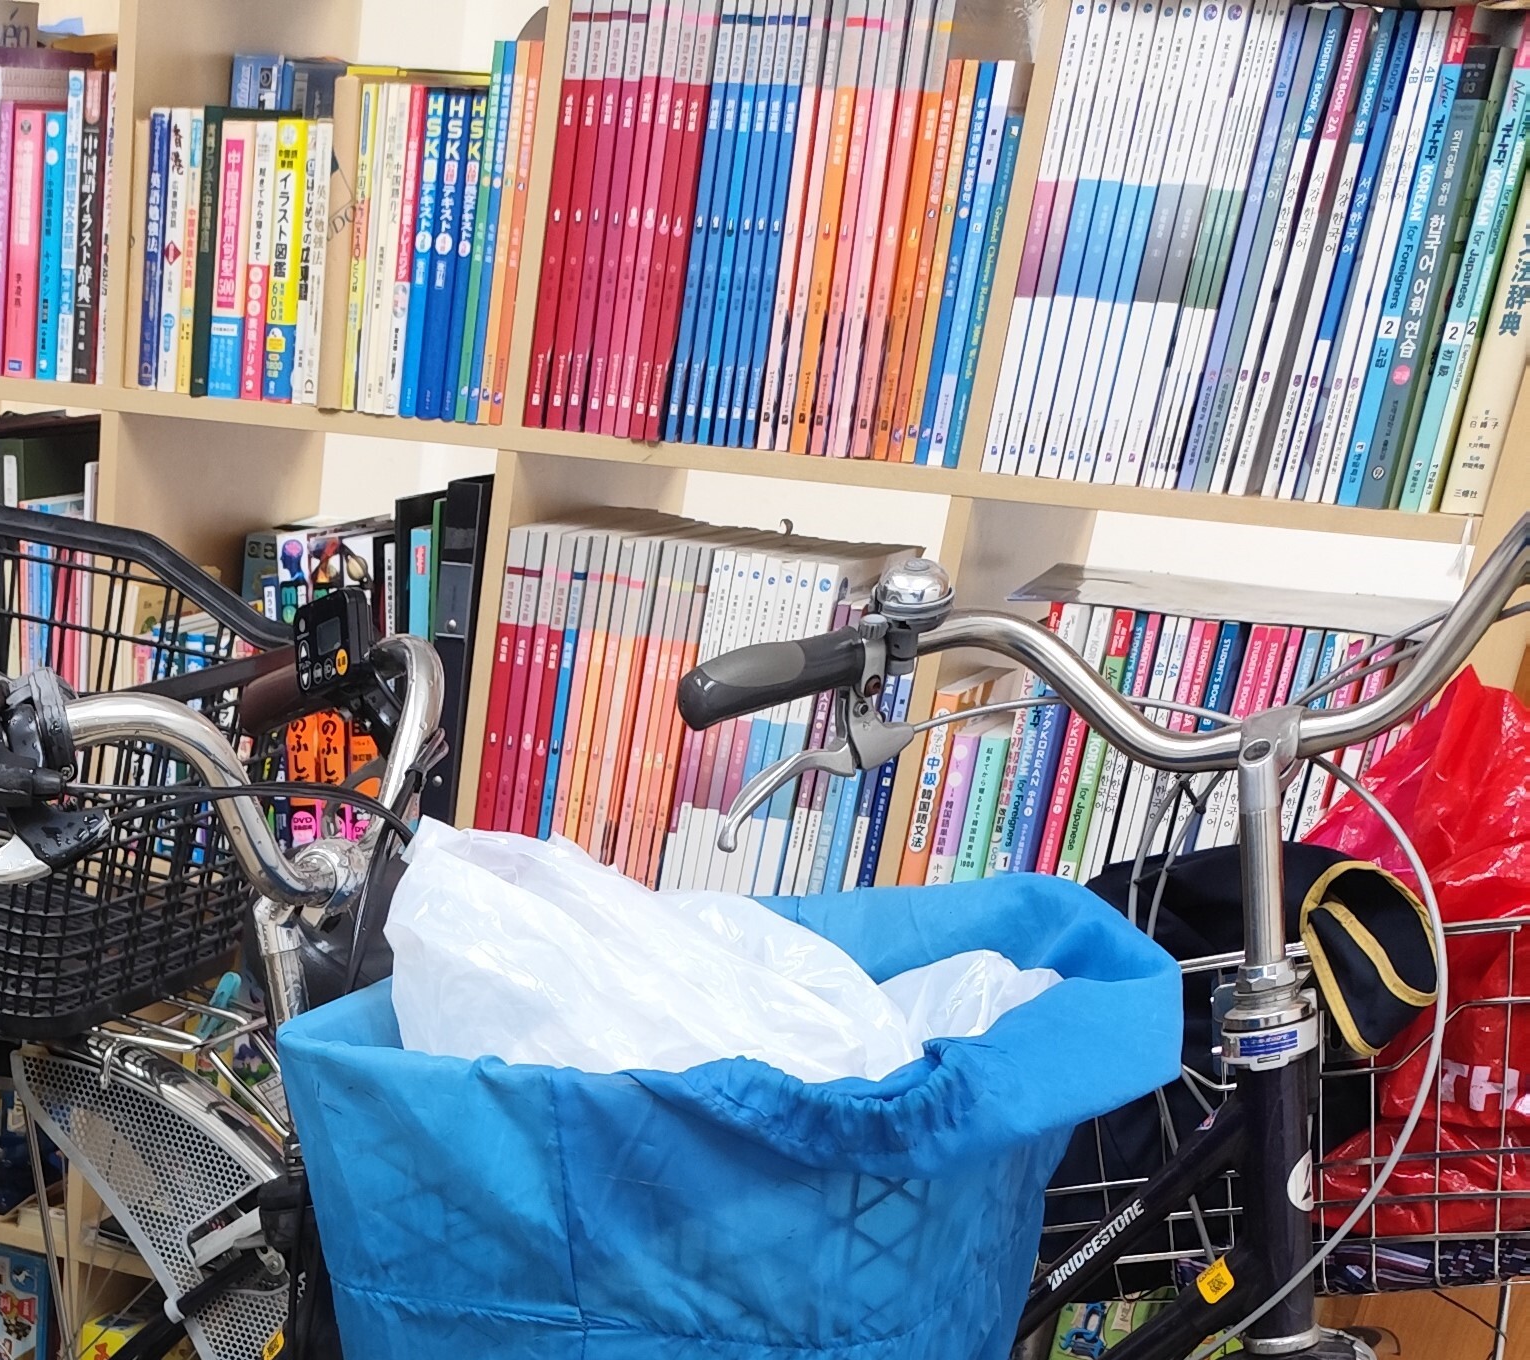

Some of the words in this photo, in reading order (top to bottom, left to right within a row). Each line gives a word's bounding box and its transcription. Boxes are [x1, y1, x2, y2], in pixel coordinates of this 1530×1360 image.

[1310, 82, 1324, 116] BOOK
[1333, 88, 1347, 113] BOOK
[423, 95, 444, 160] HSK
[444, 96, 465, 161] HSK
[467, 96, 487, 161] HSK
[1301, 116, 1316, 135] 4A
[1325, 115, 1340, 135] 2A
[1424, 115, 1446, 161] 가나다
[1493, 118, 1516, 168] 가나다
[417, 184, 436, 231] テキスト
[438, 185, 455, 234] テキスト
[1409, 163, 1436, 222] KOREAN
[1476, 168, 1504, 227] KOREAN
[78, 134, 99, 303] 中国語イラスト辞典
[273, 173, 292, 278] イラスト図鑑
[1406, 225, 1419, 242] for
[1472, 230, 1486, 248] for
[1487, 202, 1511, 255] Foreigners
[1419, 214, 1446, 274] 한국어
[1389, 243, 1415, 310] Foreigners
[1408, 276, 1432, 318] 어휘
[1455, 248, 1480, 309] Japanese
[1384, 320, 1394, 335] 2
[1399, 319, 1421, 360] 연습
[1448, 326, 1459, 341] 2
[1466, 321, 1477, 336] 2
[1374, 346, 1389, 369] 고급
[1436, 348, 1455, 378] 初級
[1454, 343, 1471, 391] Elementary
[1154, 661, 1165, 677] 4B
[1167, 663, 1179, 679] 4A
[1214, 638, 1232, 683] STUDENT'S
[1244, 639, 1263, 685] STUDENT'S
[1208, 683, 1220, 710] BOOK
[1080, 737, 1102, 785] KOREAN
[1078, 787, 1090, 800] for
[1004, 794, 1026, 848] Foreigners
[1067, 801, 1086, 851] Japanese
[1000, 855, 1008, 868] 1
[1061, 865, 1071, 876] 2
[1047, 1198, 1145, 1292] BRIDGESTONE
